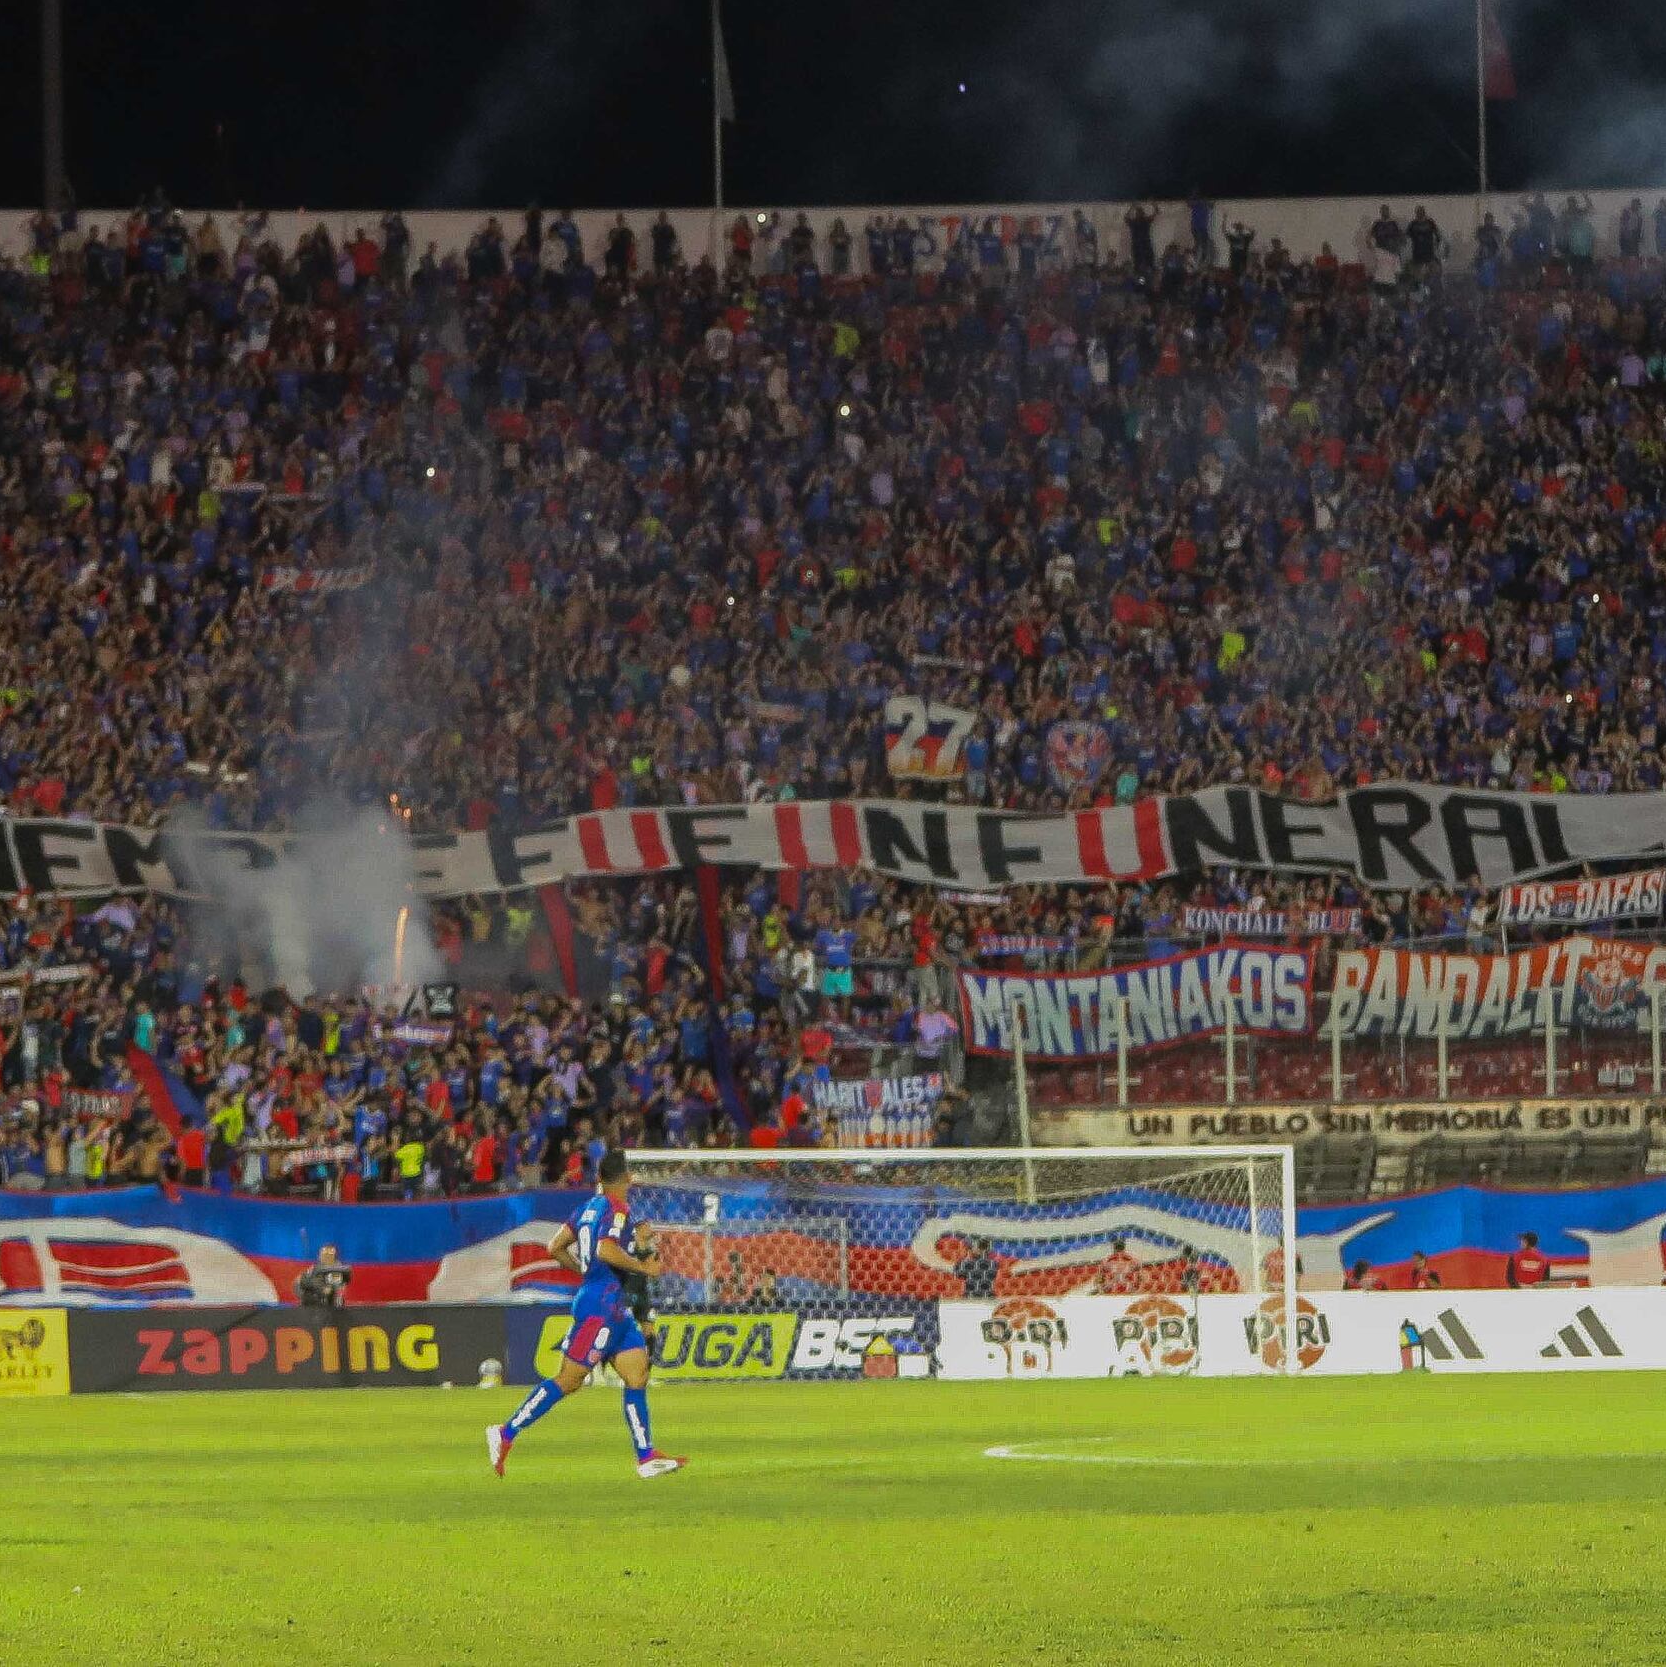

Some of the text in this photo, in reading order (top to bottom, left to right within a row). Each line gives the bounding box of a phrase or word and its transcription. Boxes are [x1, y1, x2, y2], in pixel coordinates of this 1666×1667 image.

[885, 694, 977, 779] 27
[1129, 1115, 1172, 1134] UN
[1189, 1112, 1308, 1134] PUEBLO
[1538, 1107, 1571, 1129] ES
[1583, 1105, 1630, 1127] UN
